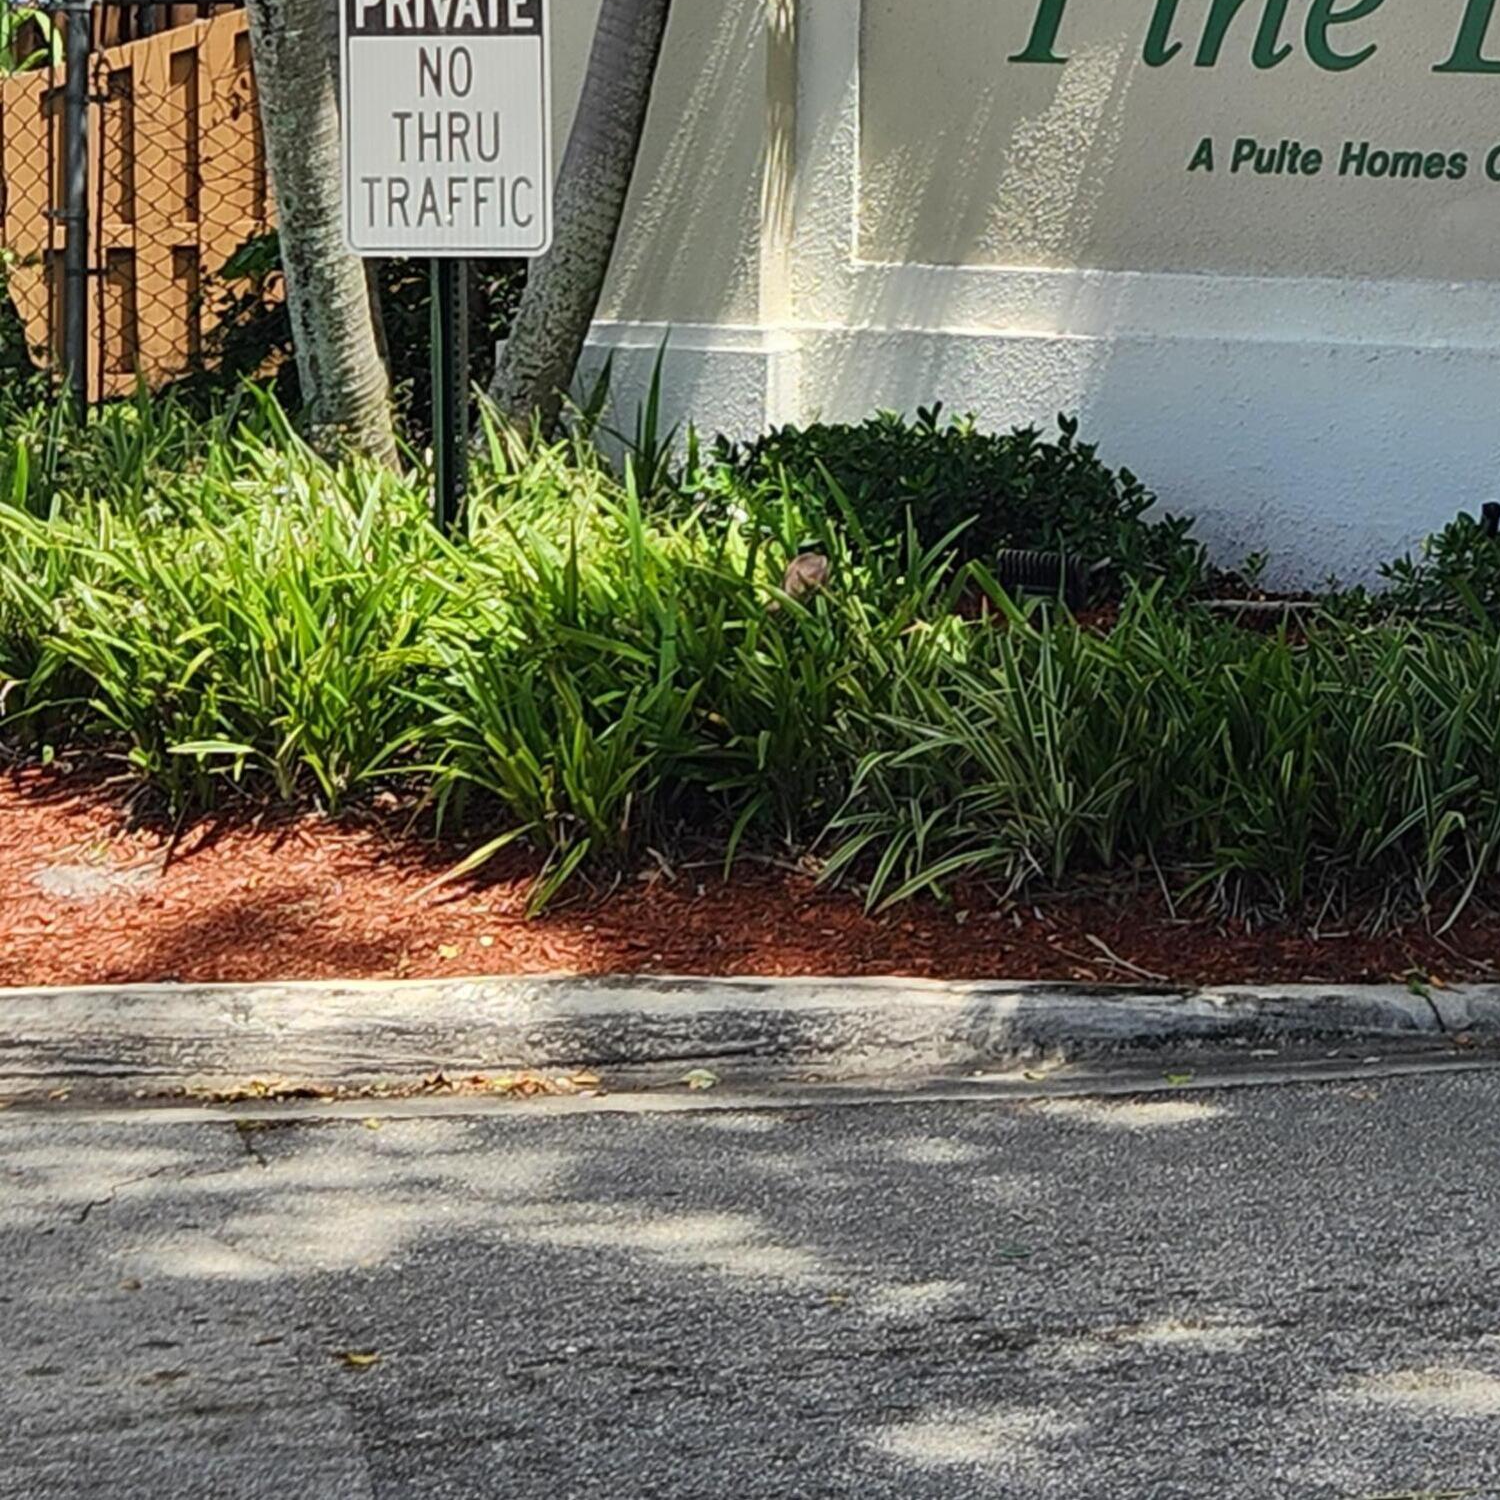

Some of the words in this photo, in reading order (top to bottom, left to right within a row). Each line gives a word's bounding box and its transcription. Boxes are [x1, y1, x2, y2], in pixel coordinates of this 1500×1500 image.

[419, 46, 472, 97] NO
[392, 111, 500, 162] THRU
[1187, 137, 1214, 172] A
[1229, 138, 1323, 175] Pulte
[1338, 141, 1468, 180] Homes
[361, 176, 533, 228] TRAFFIC
